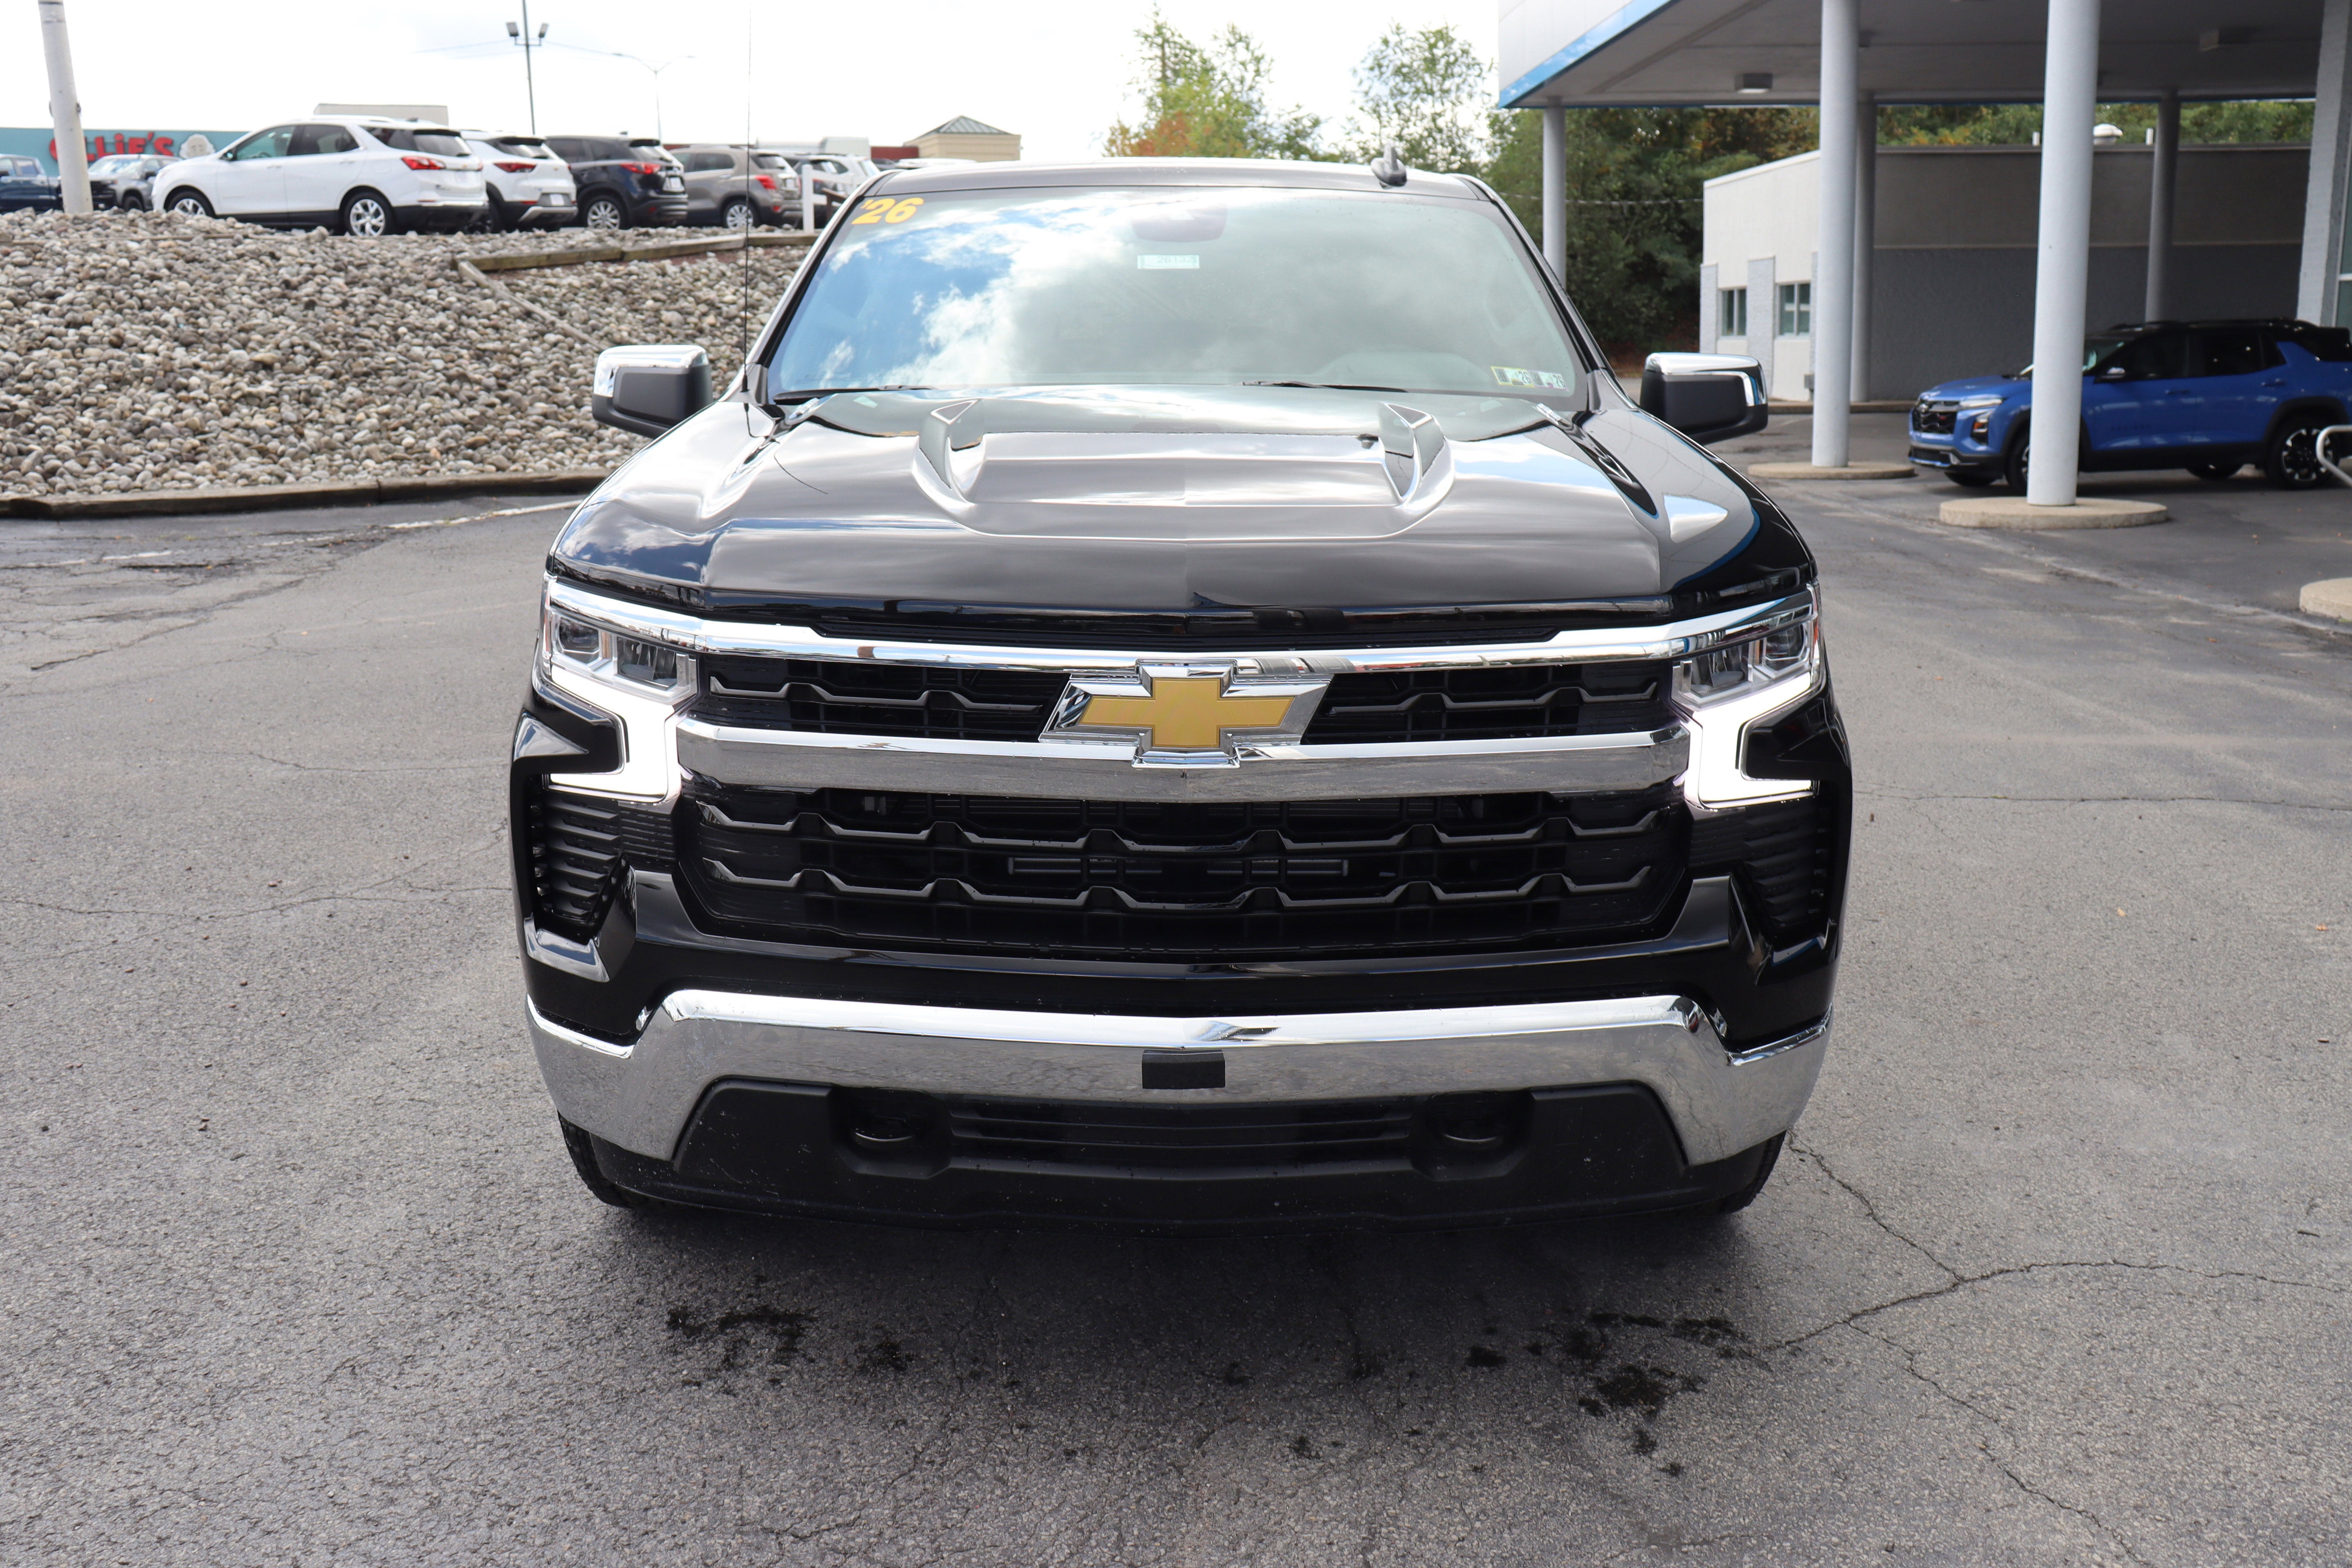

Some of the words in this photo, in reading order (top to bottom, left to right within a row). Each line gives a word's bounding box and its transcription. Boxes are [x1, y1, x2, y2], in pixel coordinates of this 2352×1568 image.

[851, 198, 924, 224] '26
[1518, 371, 1532, 383] 26
[1553, 374, 1566, 388] 26
